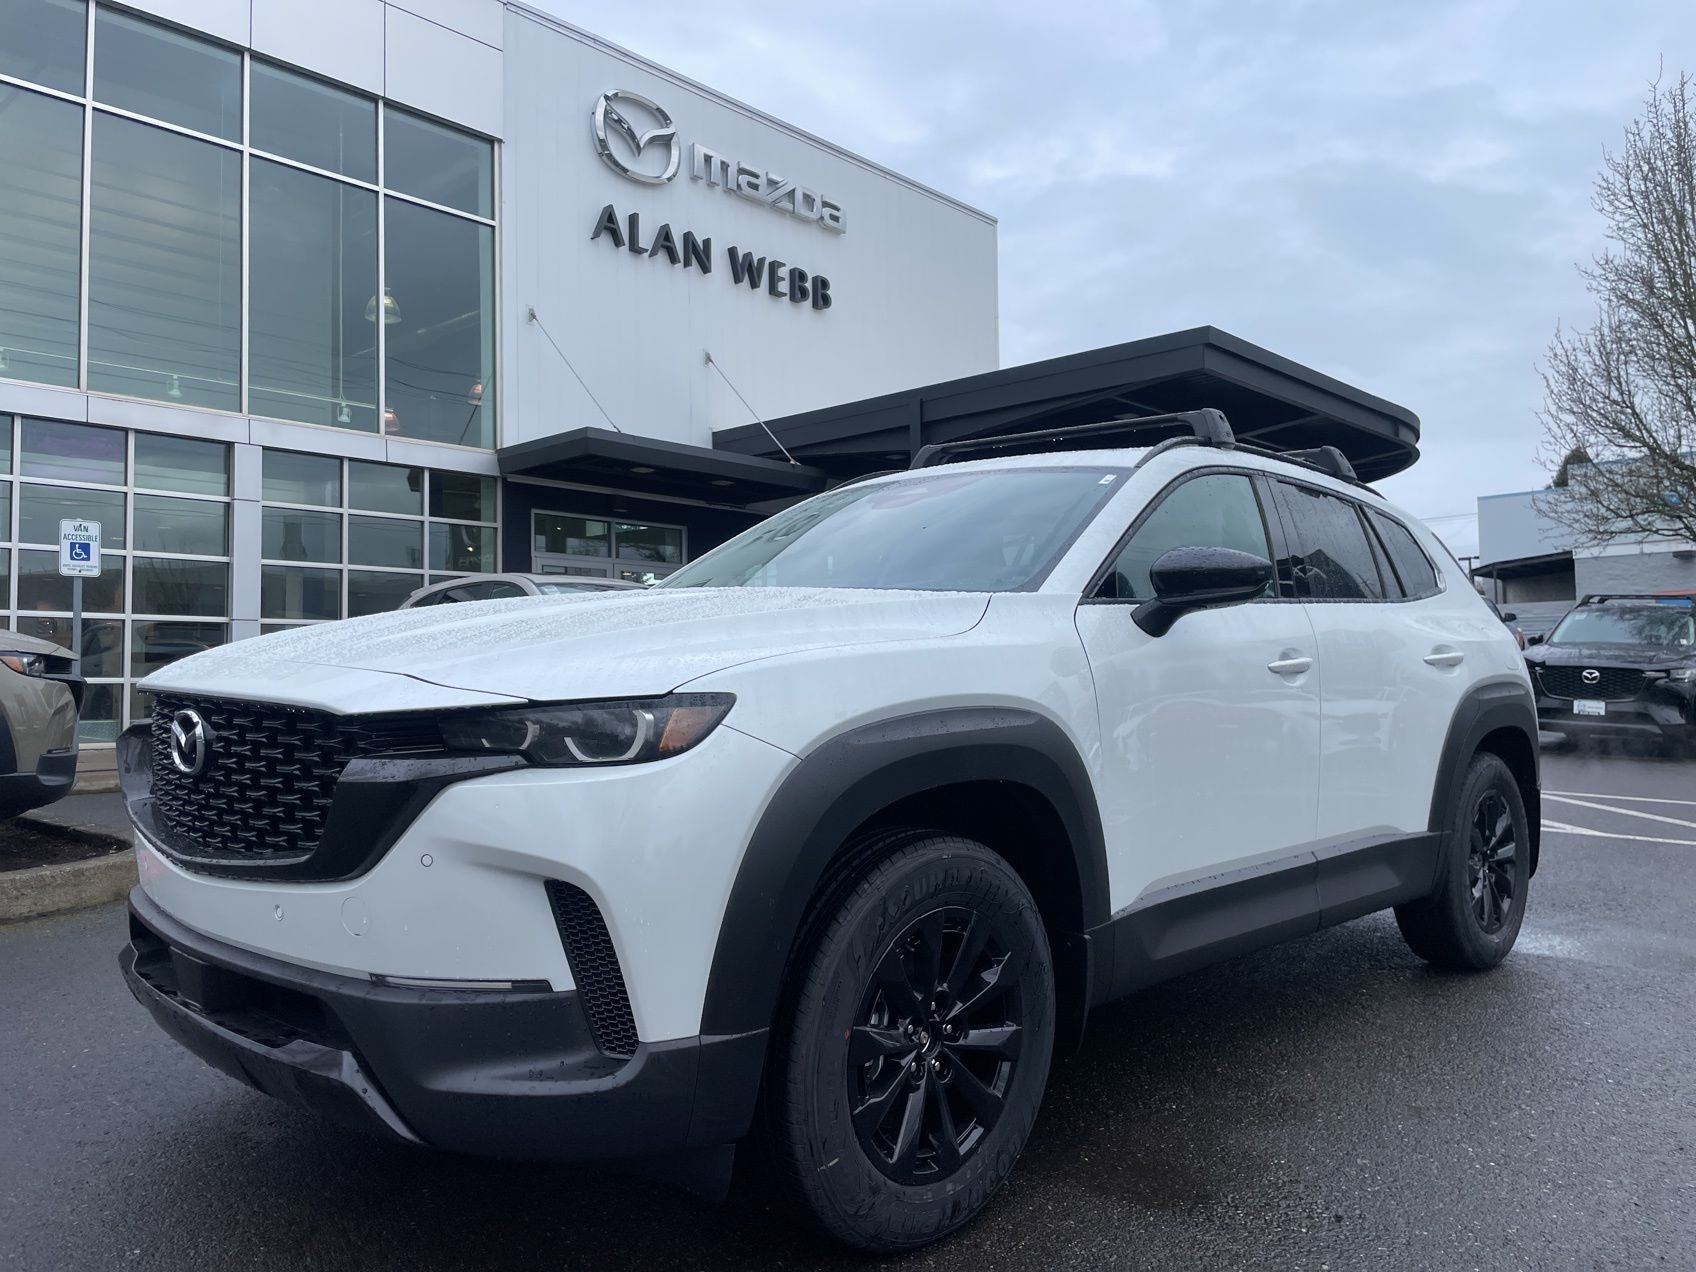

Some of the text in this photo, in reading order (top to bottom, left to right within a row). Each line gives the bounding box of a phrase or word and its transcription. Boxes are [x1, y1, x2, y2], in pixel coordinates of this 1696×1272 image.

[590, 204, 832, 311] ALAN WEBB
[63, 533, 98, 542] ACCESSIBLE
